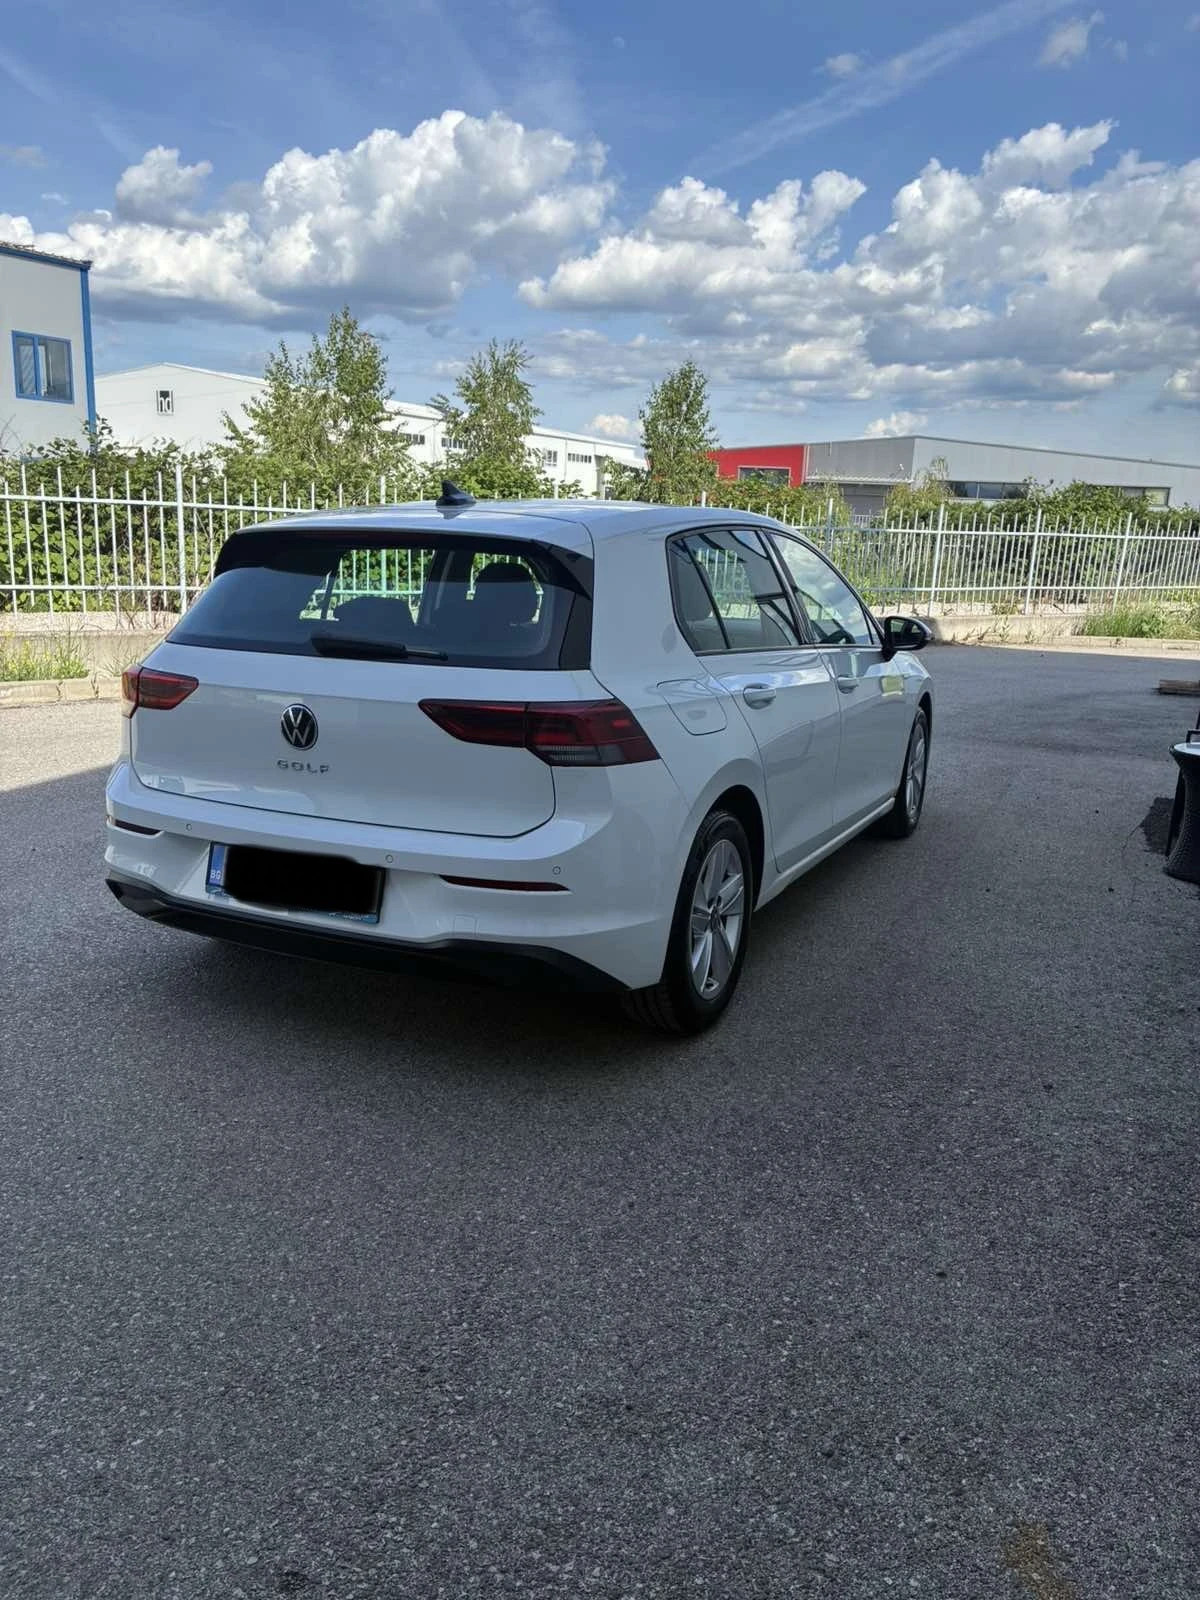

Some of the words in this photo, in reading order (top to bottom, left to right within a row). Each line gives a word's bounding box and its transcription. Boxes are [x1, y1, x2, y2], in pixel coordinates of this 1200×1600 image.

[281, 704, 318, 750] VW
[277, 759, 330, 774] GOLF
[210, 869, 222, 880] BG
